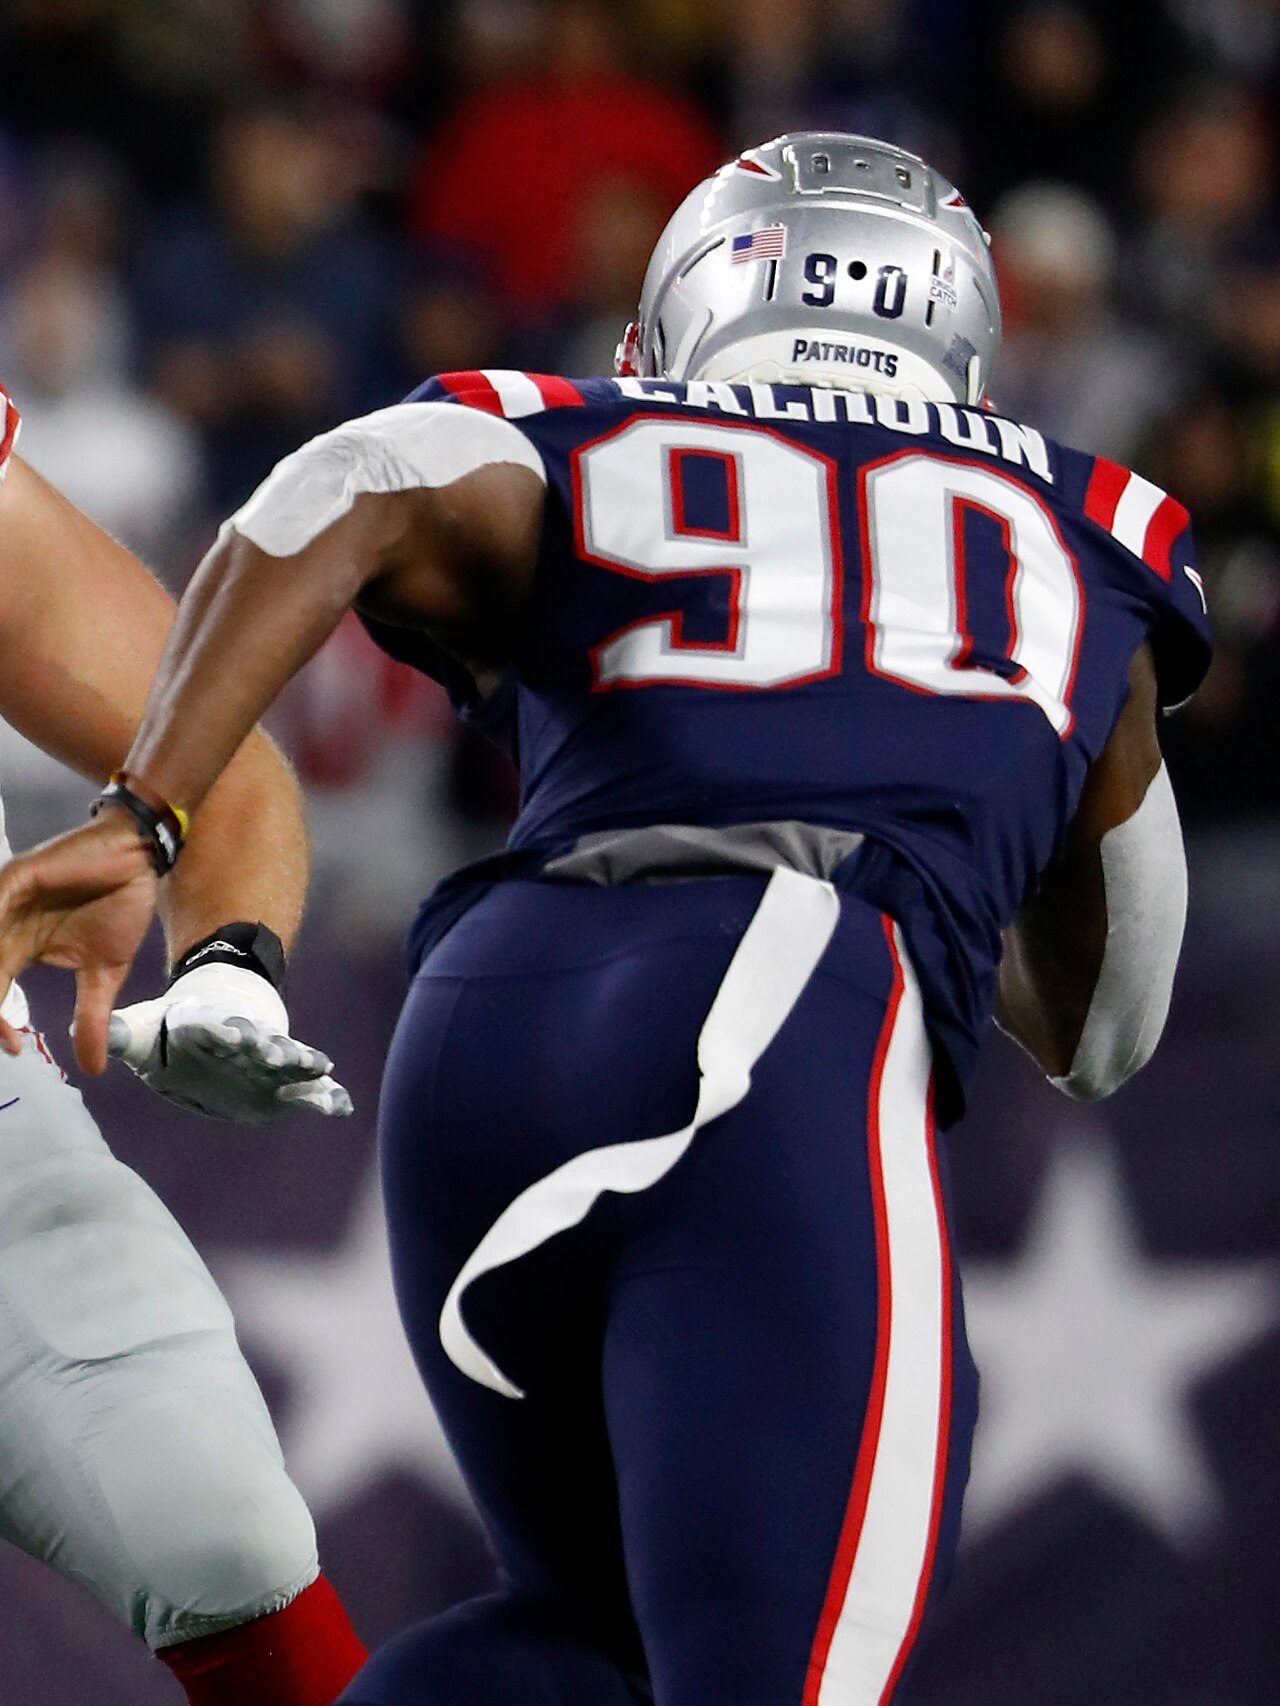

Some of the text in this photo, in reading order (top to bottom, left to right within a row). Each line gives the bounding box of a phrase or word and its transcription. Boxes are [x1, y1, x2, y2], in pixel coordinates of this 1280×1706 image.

[802, 253, 908, 320] 90
[792, 339, 898, 378] PATRIOTS
[575, 411, 1084, 740] 90
